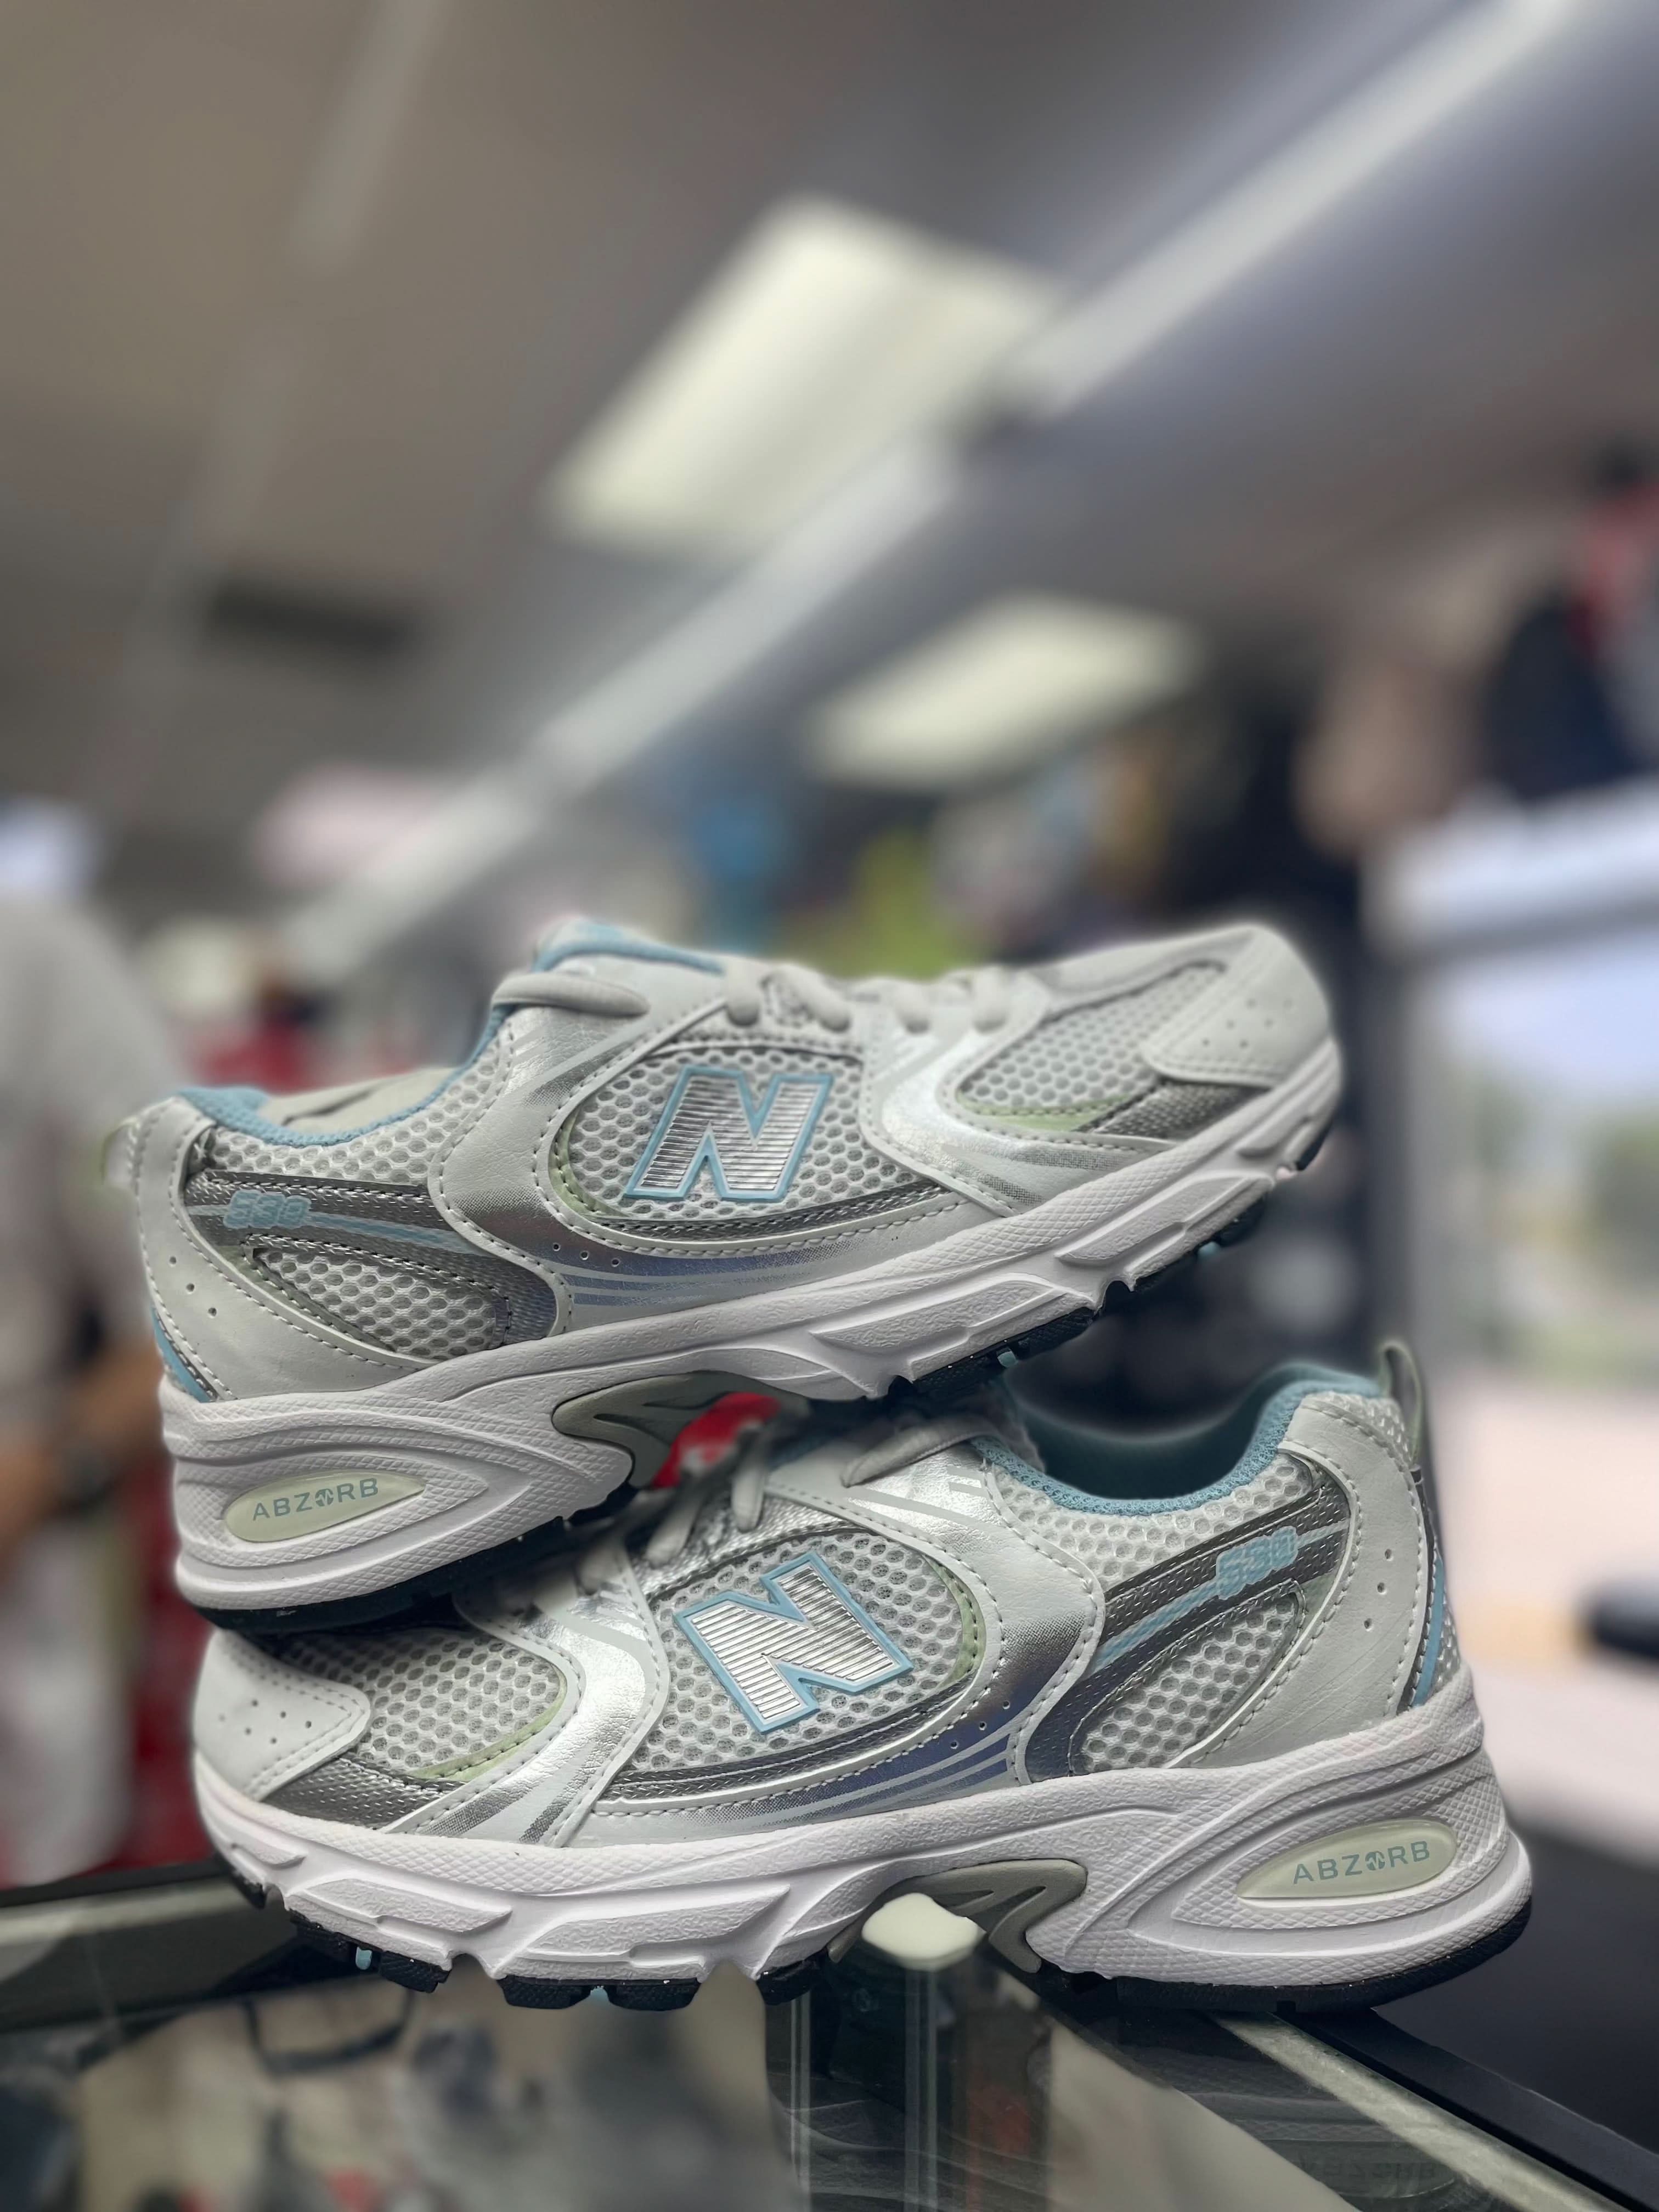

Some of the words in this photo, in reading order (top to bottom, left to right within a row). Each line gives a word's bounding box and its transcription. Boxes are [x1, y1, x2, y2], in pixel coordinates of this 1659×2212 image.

[624, 1063, 834, 1203] N
[252, 1478, 379, 1521] ABZORB
[672, 1551, 914, 1733] N
[1293, 1840, 1430, 1884] ABZORB
